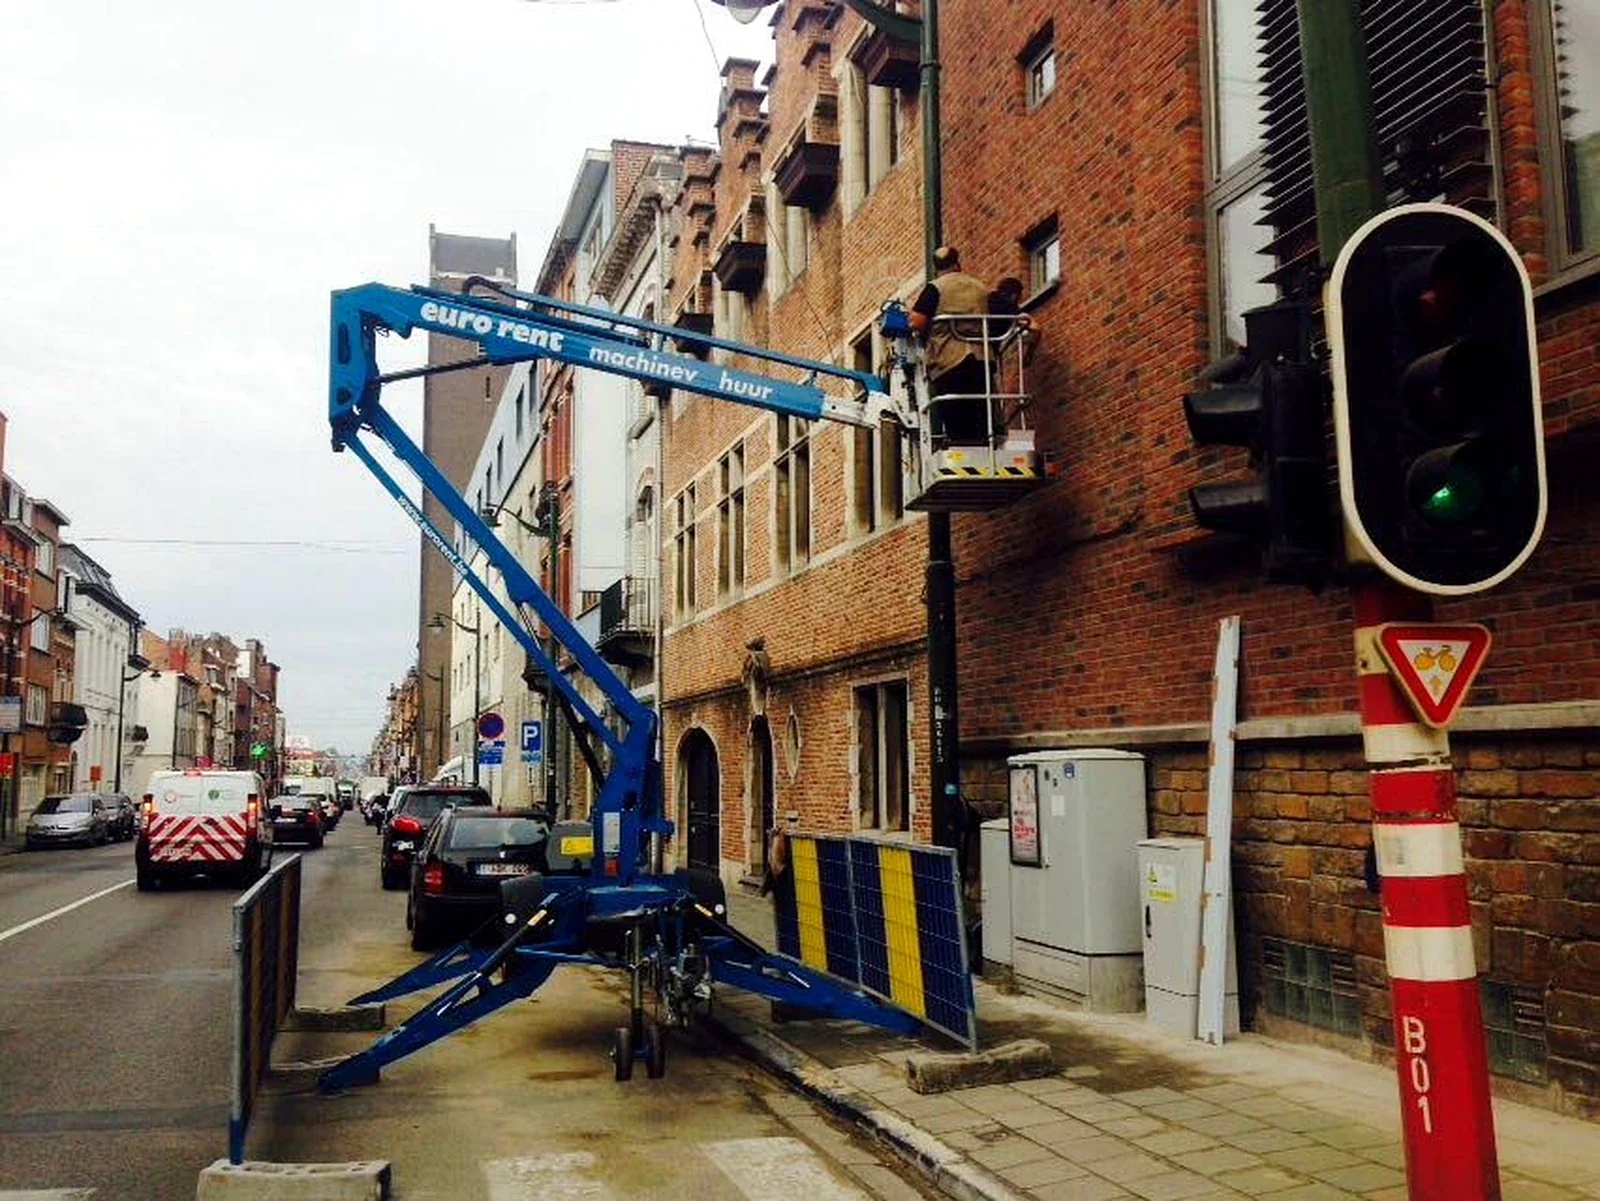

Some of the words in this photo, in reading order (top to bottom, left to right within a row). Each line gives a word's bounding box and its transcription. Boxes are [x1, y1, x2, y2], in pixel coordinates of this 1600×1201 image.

[420, 301, 493, 334] euro
[496, 319, 564, 353] rent
[718, 370, 774, 400] huur
[523, 725, 539, 747] P
